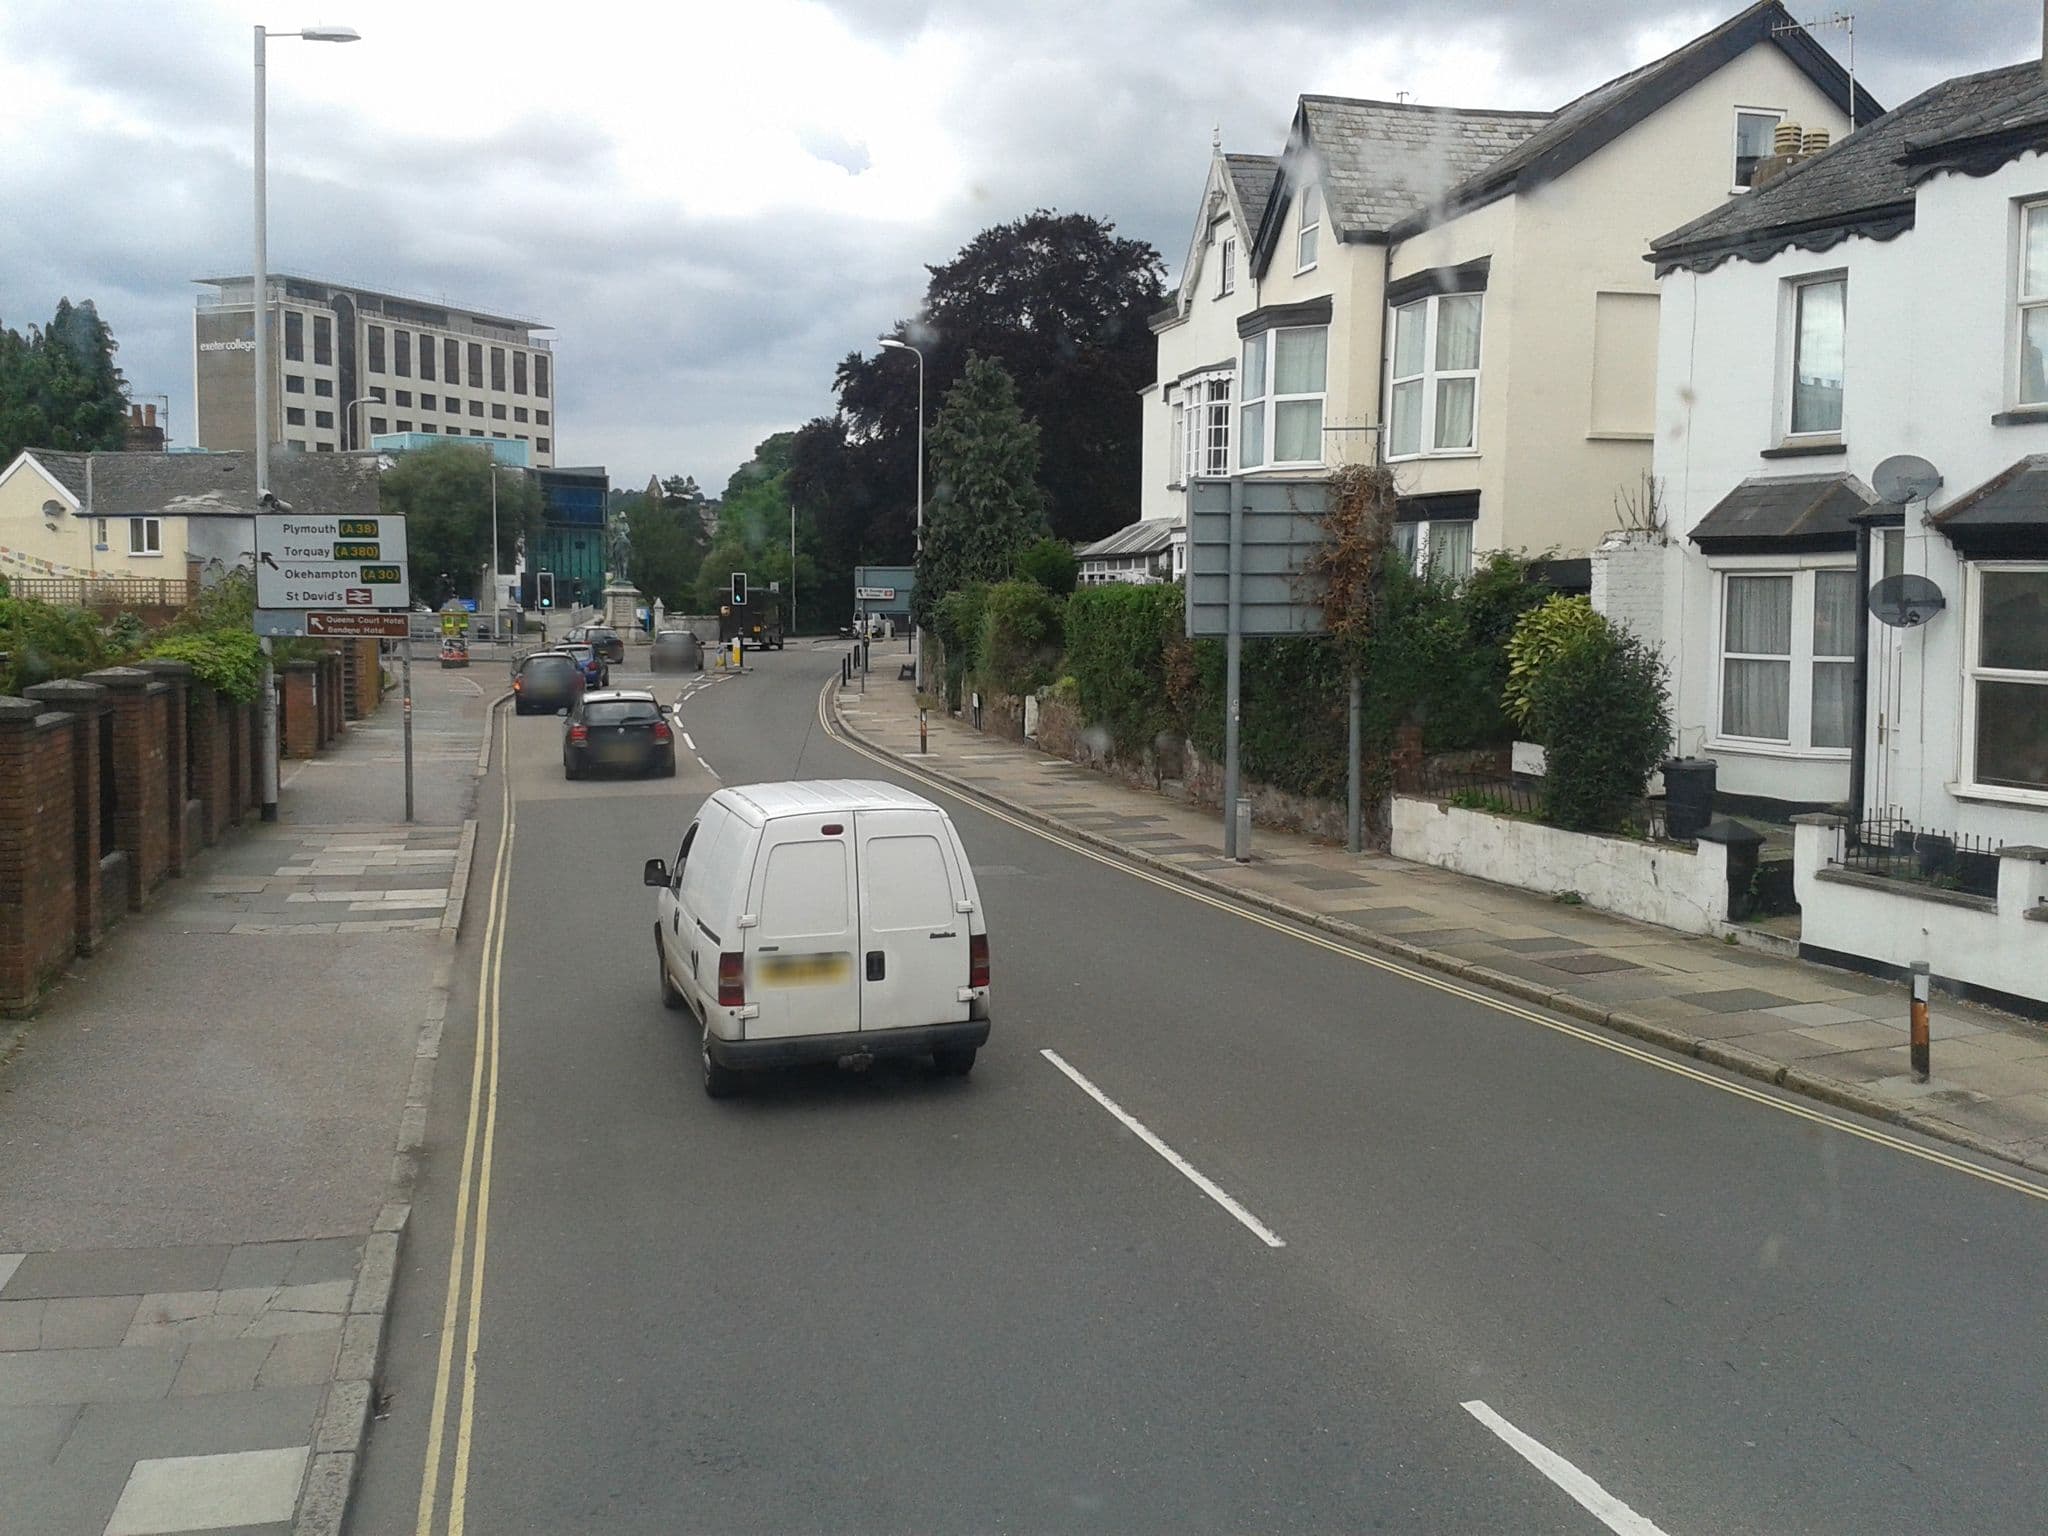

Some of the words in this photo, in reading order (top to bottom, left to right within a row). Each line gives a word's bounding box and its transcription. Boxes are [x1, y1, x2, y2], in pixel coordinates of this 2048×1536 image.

[283, 523, 337, 535] Plymouth
[284, 546, 330, 558] Torquay
[284, 569, 358, 581] Okehampton
[286, 591, 299, 601] St
[302, 591, 343, 601] David's
[358, 616, 380, 624] Court
[383, 617, 405, 625] Hotel
